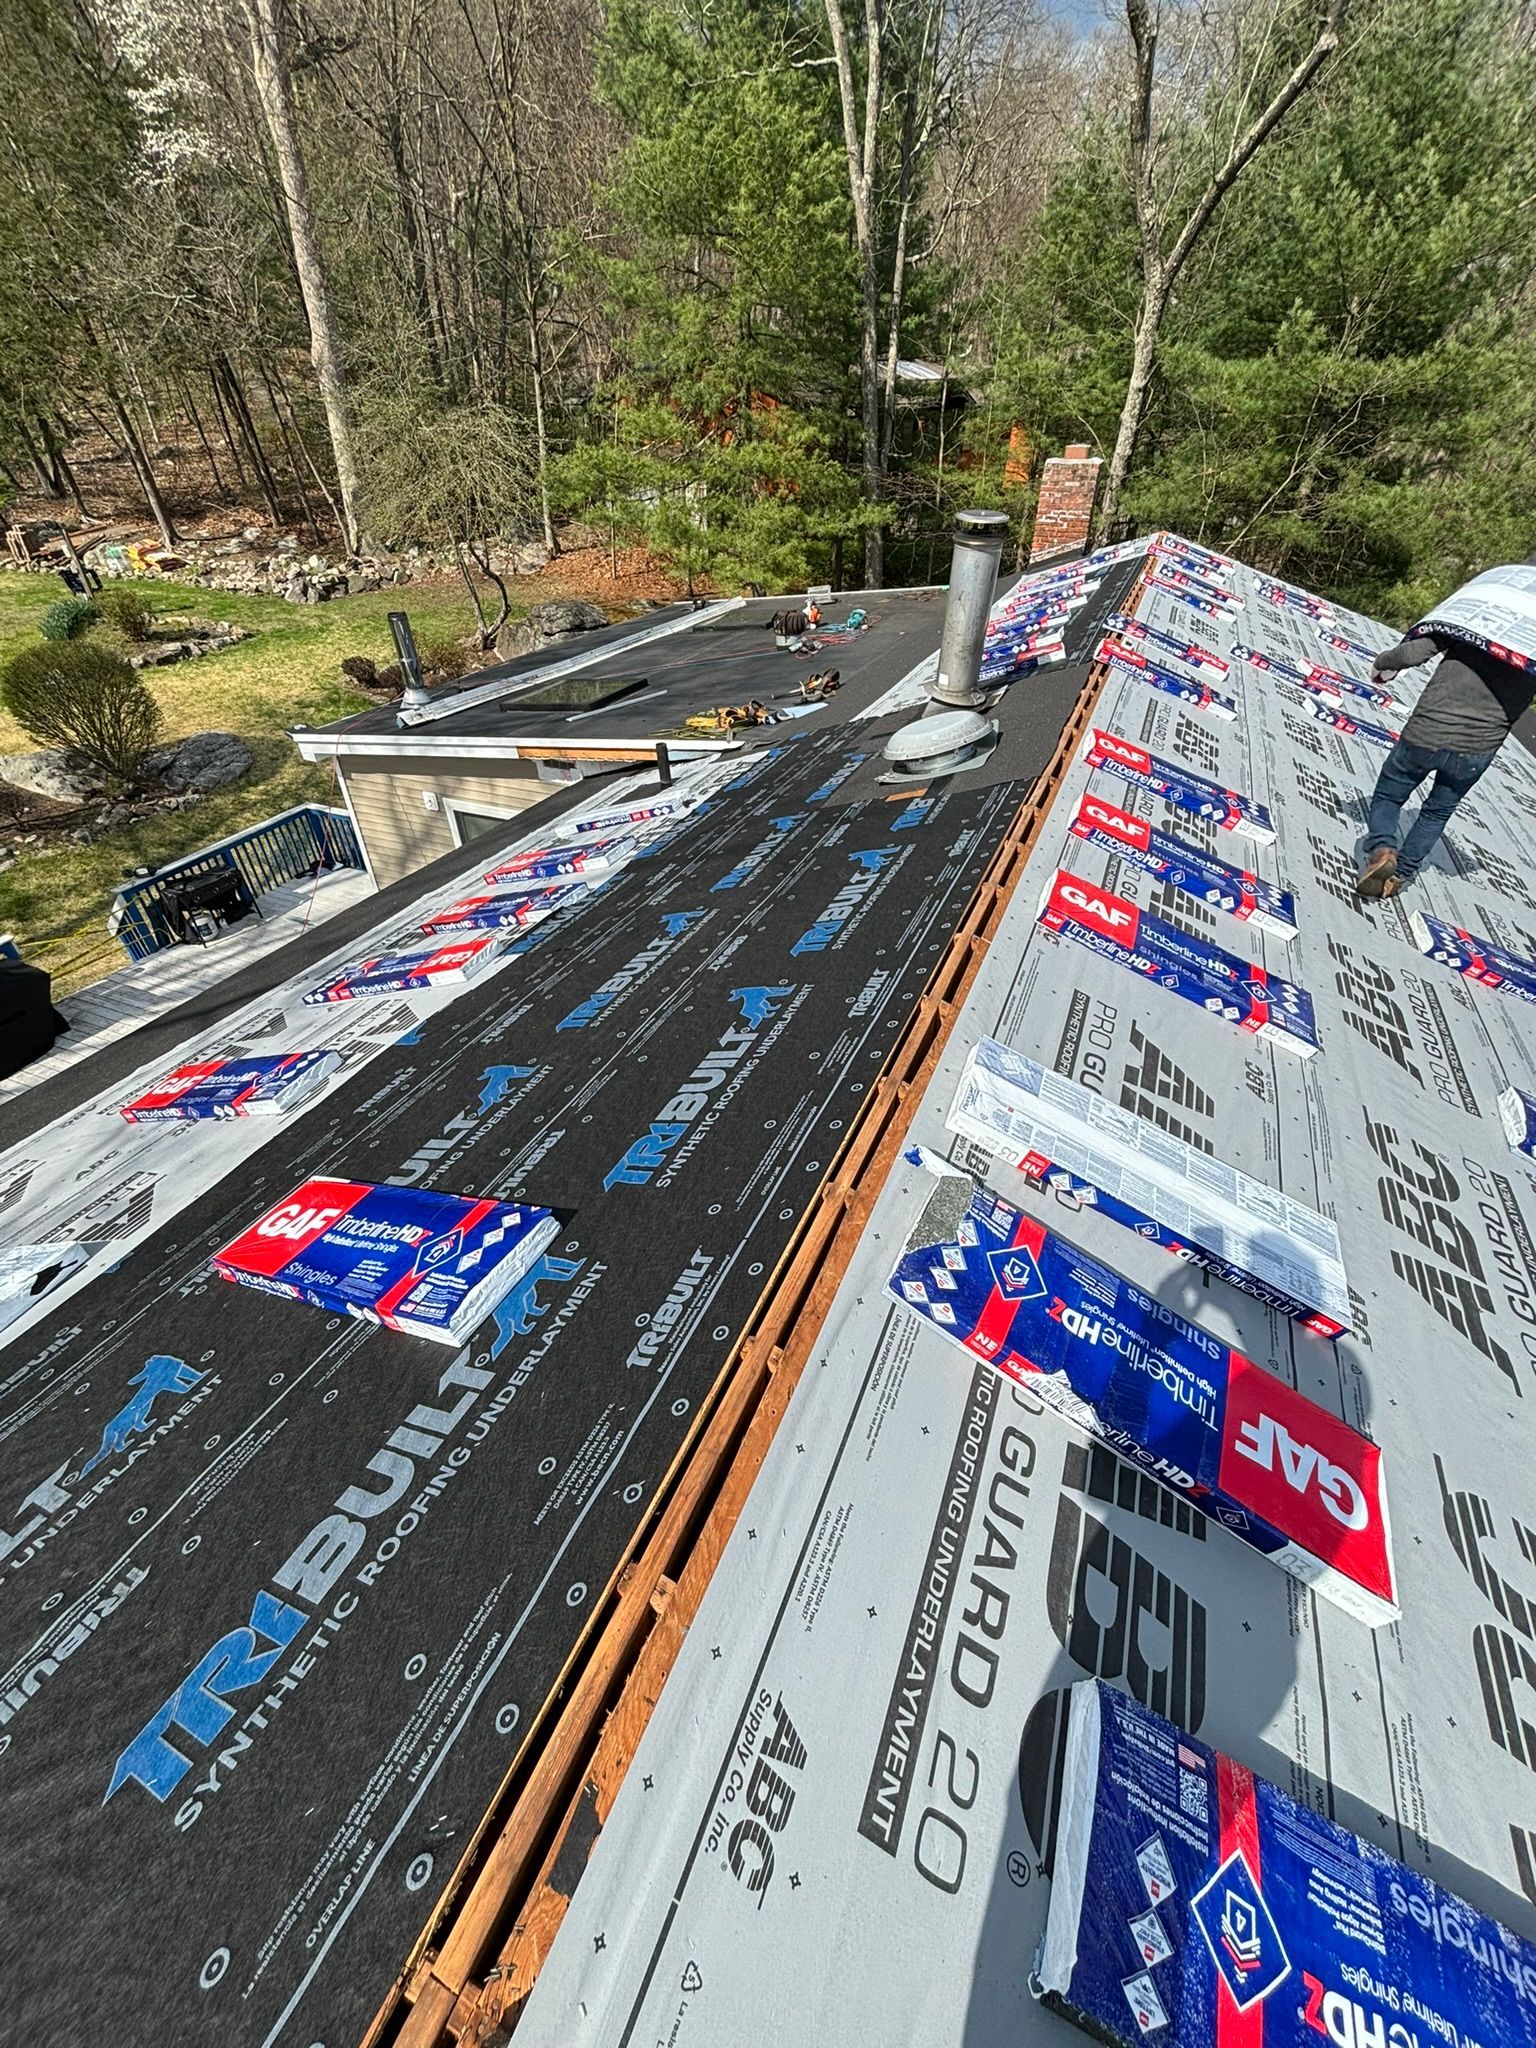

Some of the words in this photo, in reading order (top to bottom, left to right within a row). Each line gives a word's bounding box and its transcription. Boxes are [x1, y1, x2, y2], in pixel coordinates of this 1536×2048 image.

[1099, 737, 1147, 763] GAF
[1085, 804, 1146, 836] GAF
[790, 871, 881, 957] TRIBUILT
[1060, 885, 1132, 927] GAF
[556, 936, 675, 1033] TRIBUILT
[848, 966, 890, 1018] TRIBUILT
[1400, 969, 1421, 992] 20
[590, 985, 638, 1028] SYNTHETIC
[1066, 992, 1086, 1040] SYNTHETIC
[1088, 1000, 1118, 1051] PRO
[1246, 1017, 1262, 1029] NE
[1327, 932, 1426, 1090] ABC
[1407, 994, 1441, 1059] GUARD
[153, 1075, 201, 1095] GAF
[656, 1111, 721, 1188] SYNTHETIC
[715, 1056, 760, 1111] ROOFING
[754, 983, 816, 1058] UNDERLAYMENT
[1428, 1062, 1459, 1107] PRO
[461, 1064, 555, 1149] UNDERLAYMENT
[603, 1025, 759, 1192] TRIBUILT
[1021, 1161, 1041, 1174] NE
[1462, 1157, 1495, 1199] 20
[256, 1205, 342, 1241] GAF
[1011, 1264, 1021, 1276] 4
[1362, 1104, 1523, 1398] ABC
[1478, 1201, 1536, 1325] GUARD
[285, 1262, 337, 1286] Shingles
[626, 1248, 714, 1369] TRIBUILT
[890, 1313, 902, 1331] LÍNEA
[1079, 1299, 1114, 1326] Shingles
[1124, 1287, 1221, 1358] Shingles
[1306, 1317, 1334, 1335] GAF
[887, 1331, 896, 1340] DE
[974, 1331, 997, 1351] NE
[870, 1340, 893, 1391] SUPERPOSICIÓN
[1194, 1376, 1216, 1398] High
[10, 1374, 223, 1568] UNDERLAYMENT
[533, 1500, 552, 1525] MEETS
[556, 1459, 578, 1489] EXCEEDS
[575, 1440, 590, 1460] ASTM
[587, 1423, 601, 1441] D226
[597, 1408, 611, 1424] TYPE
[566, 1468, 581, 1486] TYPE
[583, 1440, 599, 1460] ASTM
[574, 1429, 625, 1506] www.becn.com
[945, 1406, 987, 1521] ROOFING
[1235, 1413, 1368, 1532] GAF
[816, 1510, 832, 1541] CAN/CSA
[832, 1505, 845, 1525] ASTM
[838, 1521, 847, 1533] the
[842, 1502, 854, 1522] Meets
[174, 1590, 359, 1832] SYNTHETIC
[359, 1445, 471, 1587] ROOFING
[466, 1261, 608, 1445] UNDERLAYMENT
[807, 1540, 821, 1564] A123.3
[819, 1547, 830, 1563] Type
[100, 1346, 496, 1808] TRIBUILT
[803, 1563, 813, 1577] and
[808, 1573, 821, 1595] ASTM
[819, 1565, 833, 1587] ASTM
[944, 1425, 1040, 1710] GUARD
[794, 1577, 808, 1602] A220.1
[800, 1595, 813, 1619] D8257
[813, 1587, 825, 1606] D226
[807, 1606, 818, 1625] Type
[445, 1662, 466, 1689] techo
[868, 1526, 958, 1843] UNDERLAYMENT
[406, 1740, 437, 1783] LÍNEA
[430, 1722, 448, 1743] DE
[440, 1629, 502, 1724] SUPERPOSICIÓN
[436, 1687, 450, 1704] del
[404, 1702, 441, 1754] inclinación
[738, 1688, 770, 1766] Supply
[273, 1874, 314, 1934] resistance
[311, 1849, 330, 1874] may
[327, 1823, 347, 1849] vary
[343, 1800, 361, 1823] with
[438, 1637, 465, 1674] footwear
[461, 1621, 476, 1638] and
[471, 1604, 486, 1622] roof
[481, 1584, 498, 1606] pitch
[393, 1764, 402, 1773] y
[397, 1753, 409, 1765] la
[721, 1768, 742, 1805] Co.
[728, 1690, 810, 1910] ABC
[240, 1981, 255, 1999] La
[252, 1912, 299, 1980] resistencia
[295, 1900, 307, 1912] al
[352, 1791, 377, 1825] puede
[419, 1663, 457, 1717] condiciones
[452, 1651, 464, 1663] de
[459, 1641, 470, 1653] la
[359, 1812, 372, 1828] de
[914, 1728, 980, 1894] 20
[345, 1827, 363, 1850] tipo
[704, 1811, 728, 1853] inc.
[1170, 1821, 1208, 1856] Installation
[337, 1850, 349, 1863] el
[303, 1872, 355, 1949] OVERLAP
[349, 1837, 377, 1874] LINE
[1234, 1909, 1248, 1932] 4
[1342, 1963, 1398, 2006] Shingles
[678, 2001, 687, 2017] La
